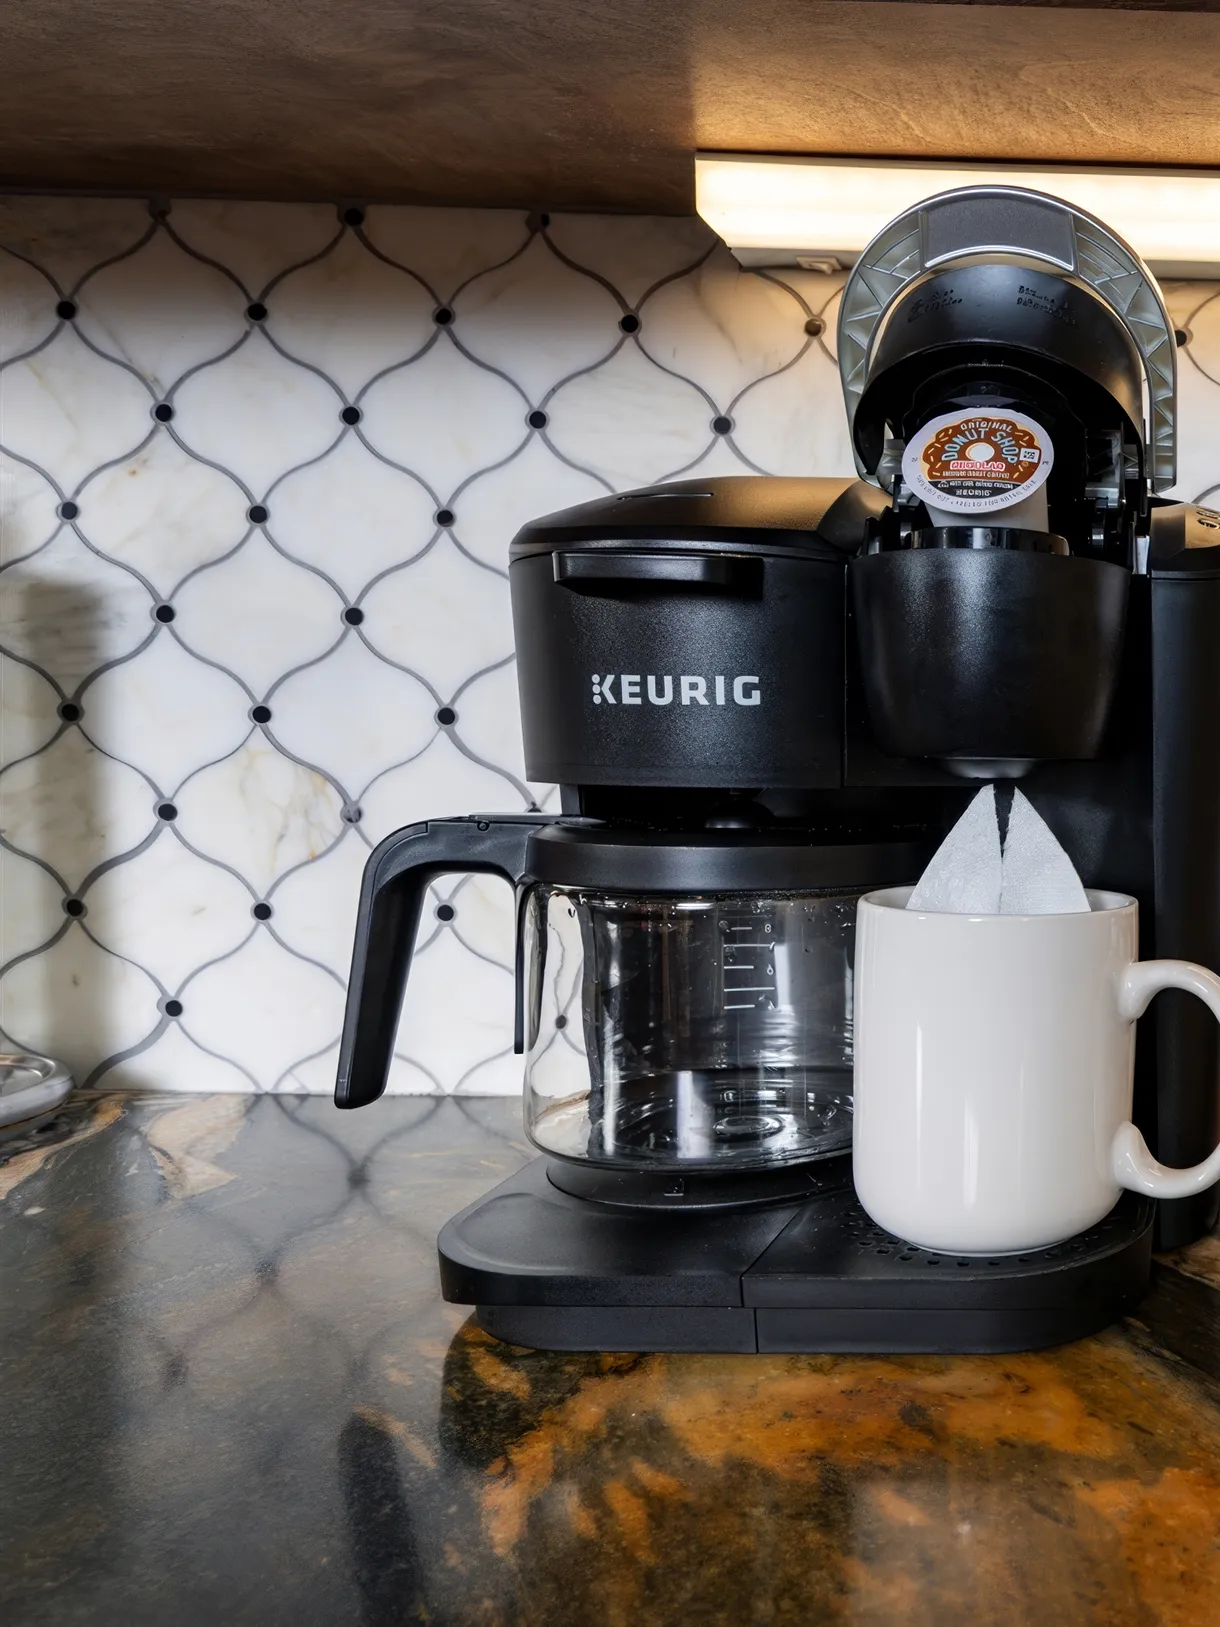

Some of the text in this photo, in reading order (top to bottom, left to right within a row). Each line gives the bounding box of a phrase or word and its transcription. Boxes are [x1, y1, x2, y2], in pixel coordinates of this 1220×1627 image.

[960, 421, 1013, 433] ORIGINAL
[941, 428, 1019, 464] DONUT SHOP
[591, 673, 761, 706] KEURIG
